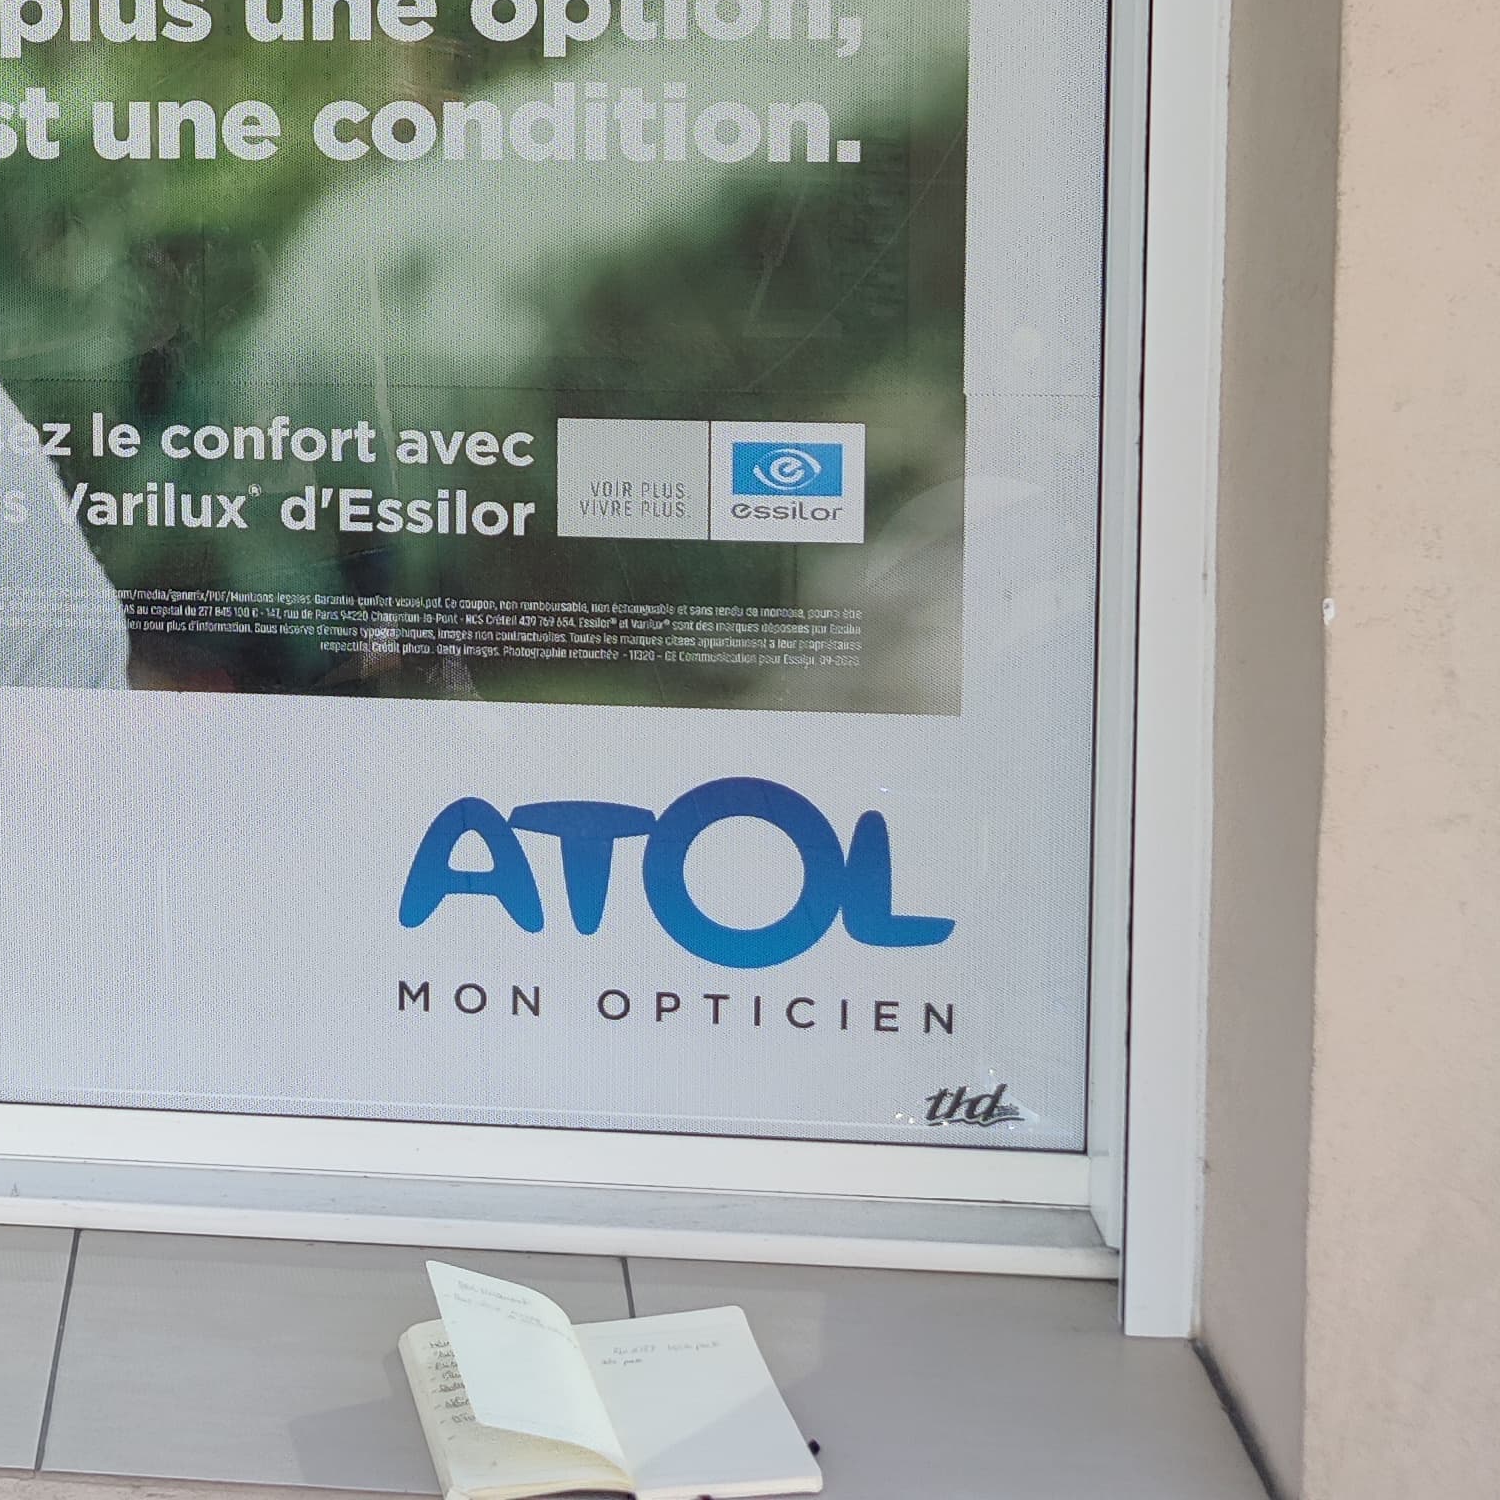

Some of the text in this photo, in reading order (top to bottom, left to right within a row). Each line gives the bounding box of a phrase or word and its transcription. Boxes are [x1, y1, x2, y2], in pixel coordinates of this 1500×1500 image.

[91, 95, 282, 162] une
[311, 81, 862, 165] condition.
[92, 412, 141, 459] le
[160, 415, 376, 463] confort
[396, 430, 535, 467] avec
[281, 485, 535, 536] d'Essilor
[579, 500, 632, 517] VIVRE
[590, 480, 632, 499] VOIR
[730, 501, 844, 521] essilor
[399, 776, 955, 969] ATOL
[398, 980, 954, 1034] MON OPTICIEN
